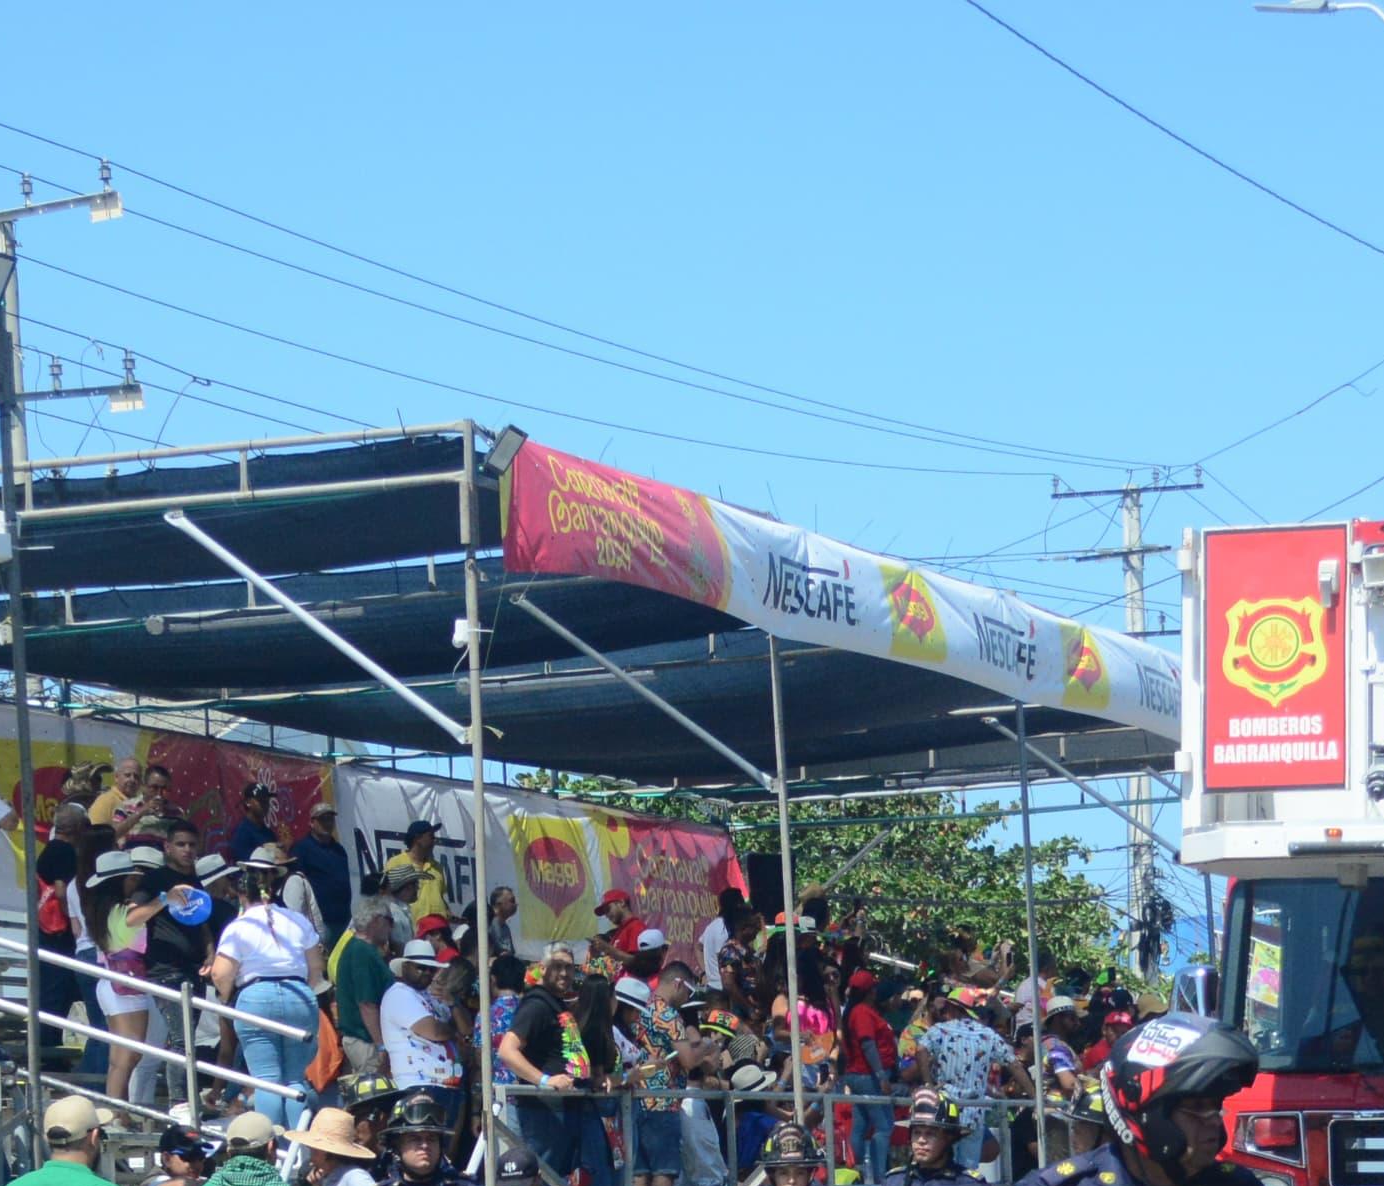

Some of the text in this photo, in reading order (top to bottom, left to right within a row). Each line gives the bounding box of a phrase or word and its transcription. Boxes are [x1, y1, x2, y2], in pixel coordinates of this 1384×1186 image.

[1228, 714, 1323, 738] BOMBEROS
[1213, 739, 1339, 765] BARRANQUILLA
[529, 858, 579, 888] Maggi
